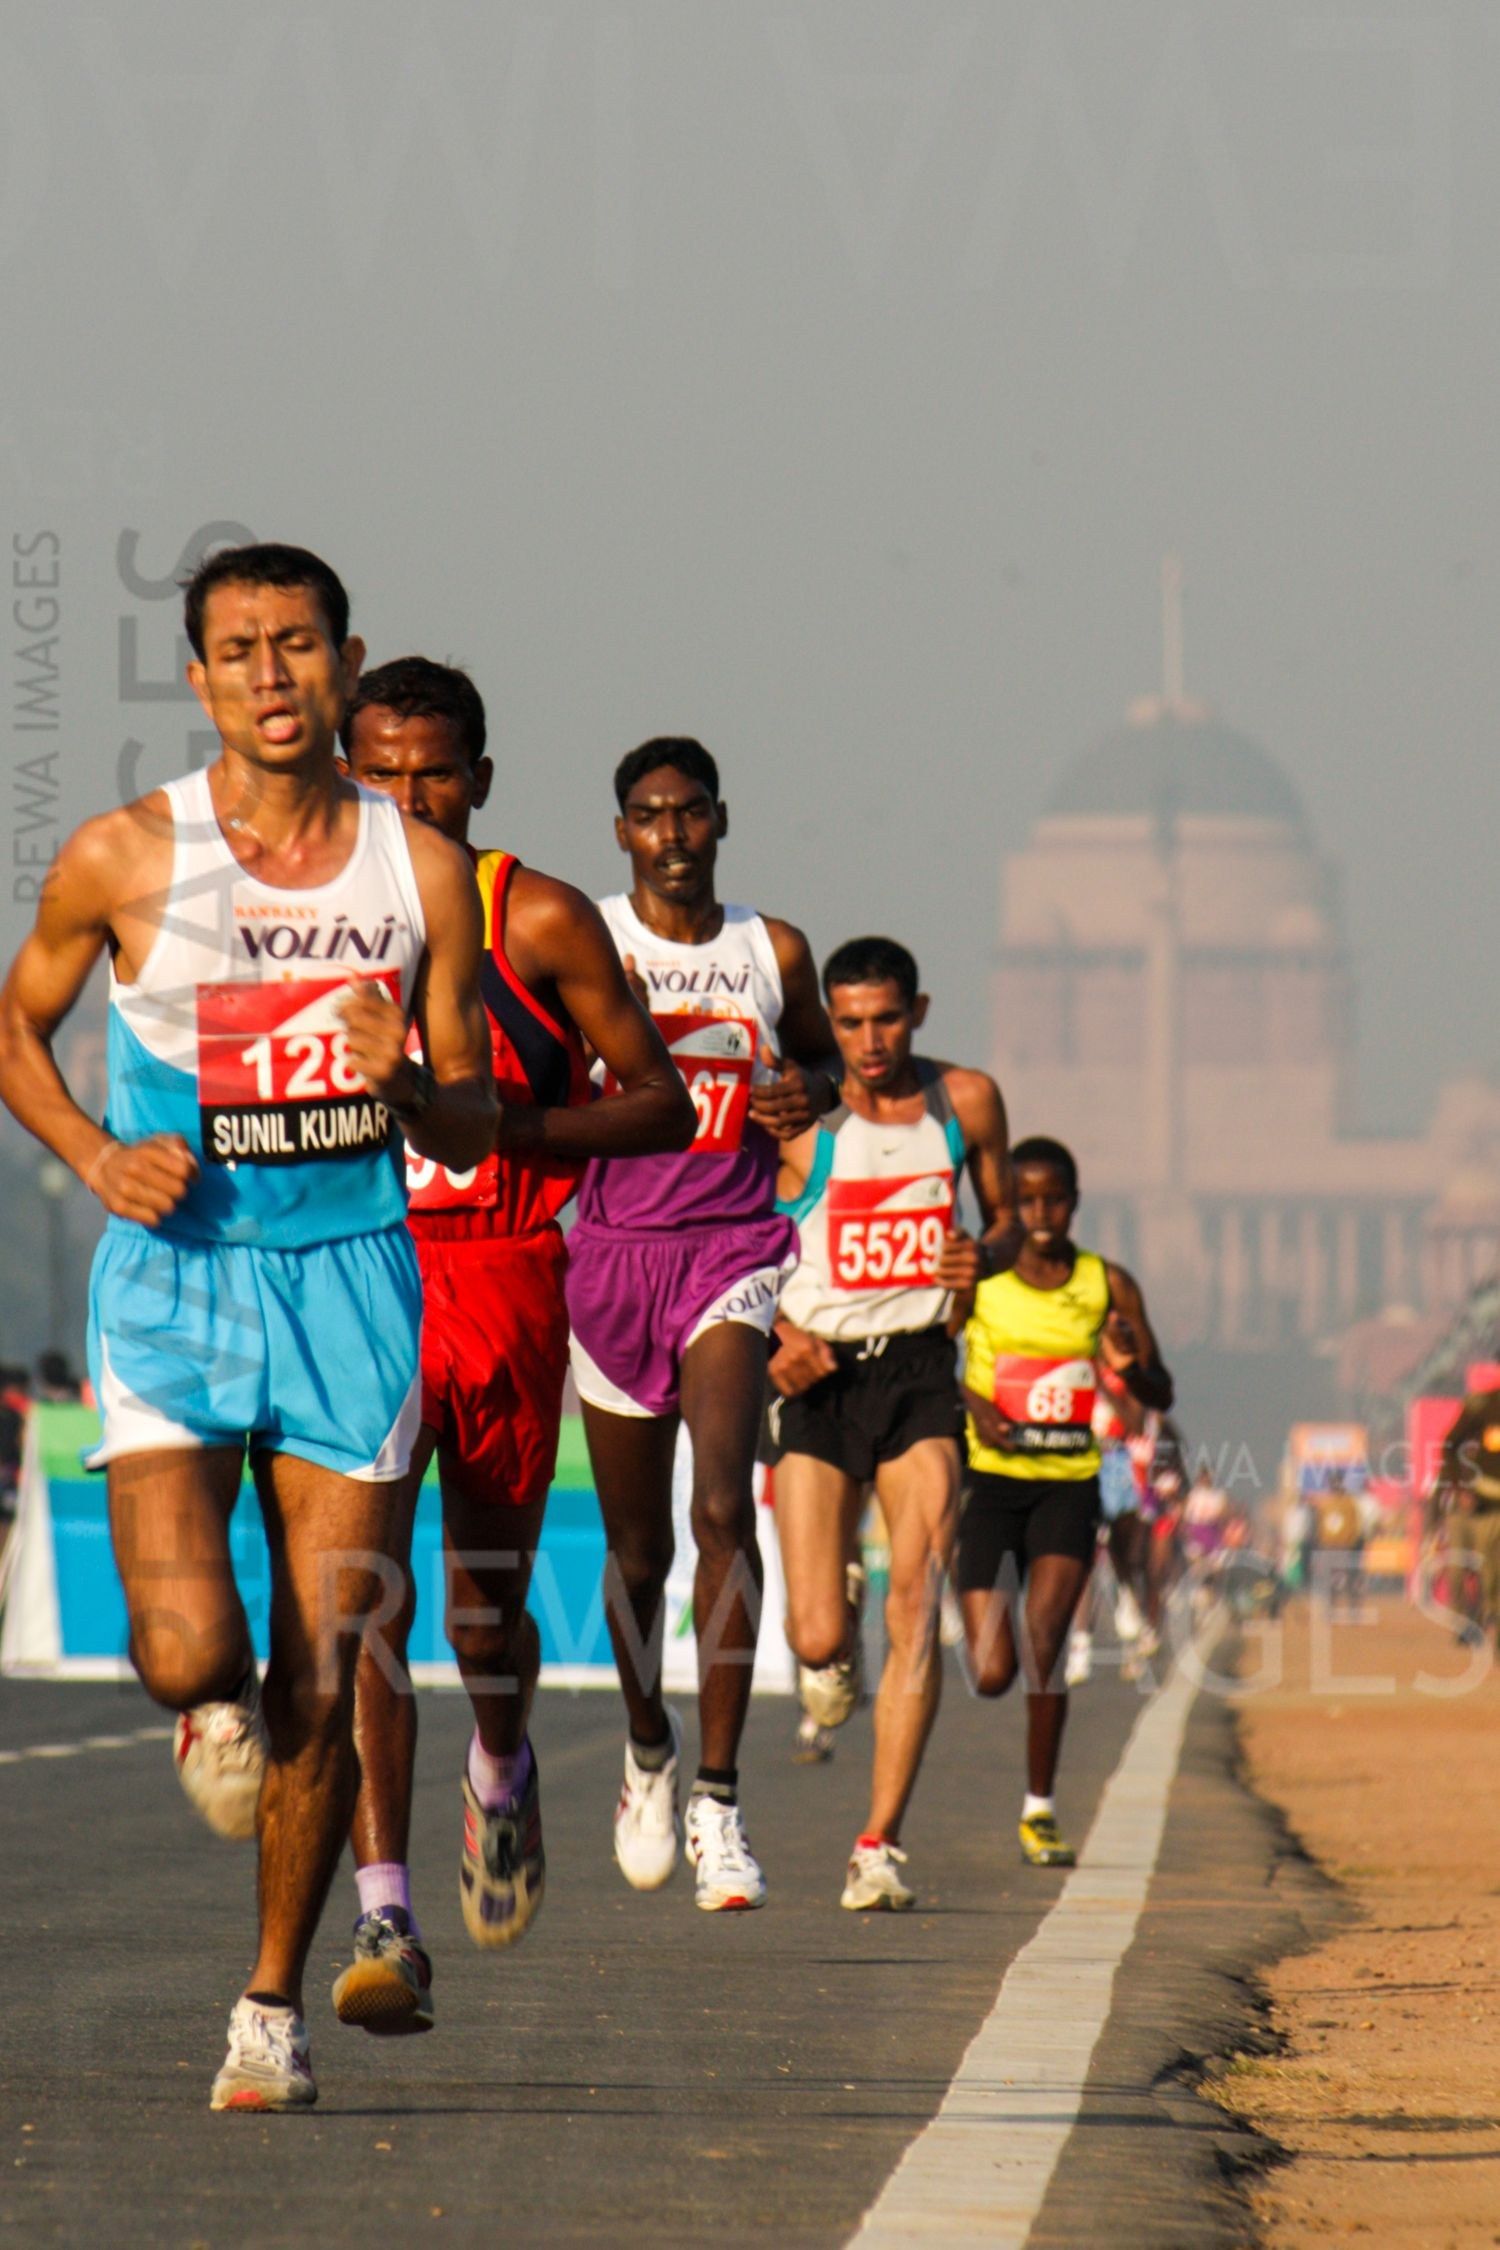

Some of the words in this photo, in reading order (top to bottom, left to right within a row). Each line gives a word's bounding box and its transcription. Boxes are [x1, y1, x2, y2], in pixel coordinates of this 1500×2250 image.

[241, 1032, 366, 1101] 128
[213, 1113, 296, 1154] SUNIL
[300, 1103, 389, 1150] KUMAR
[837, 1215, 945, 1282] 5529
[1026, 1382, 1072, 1421] 68
